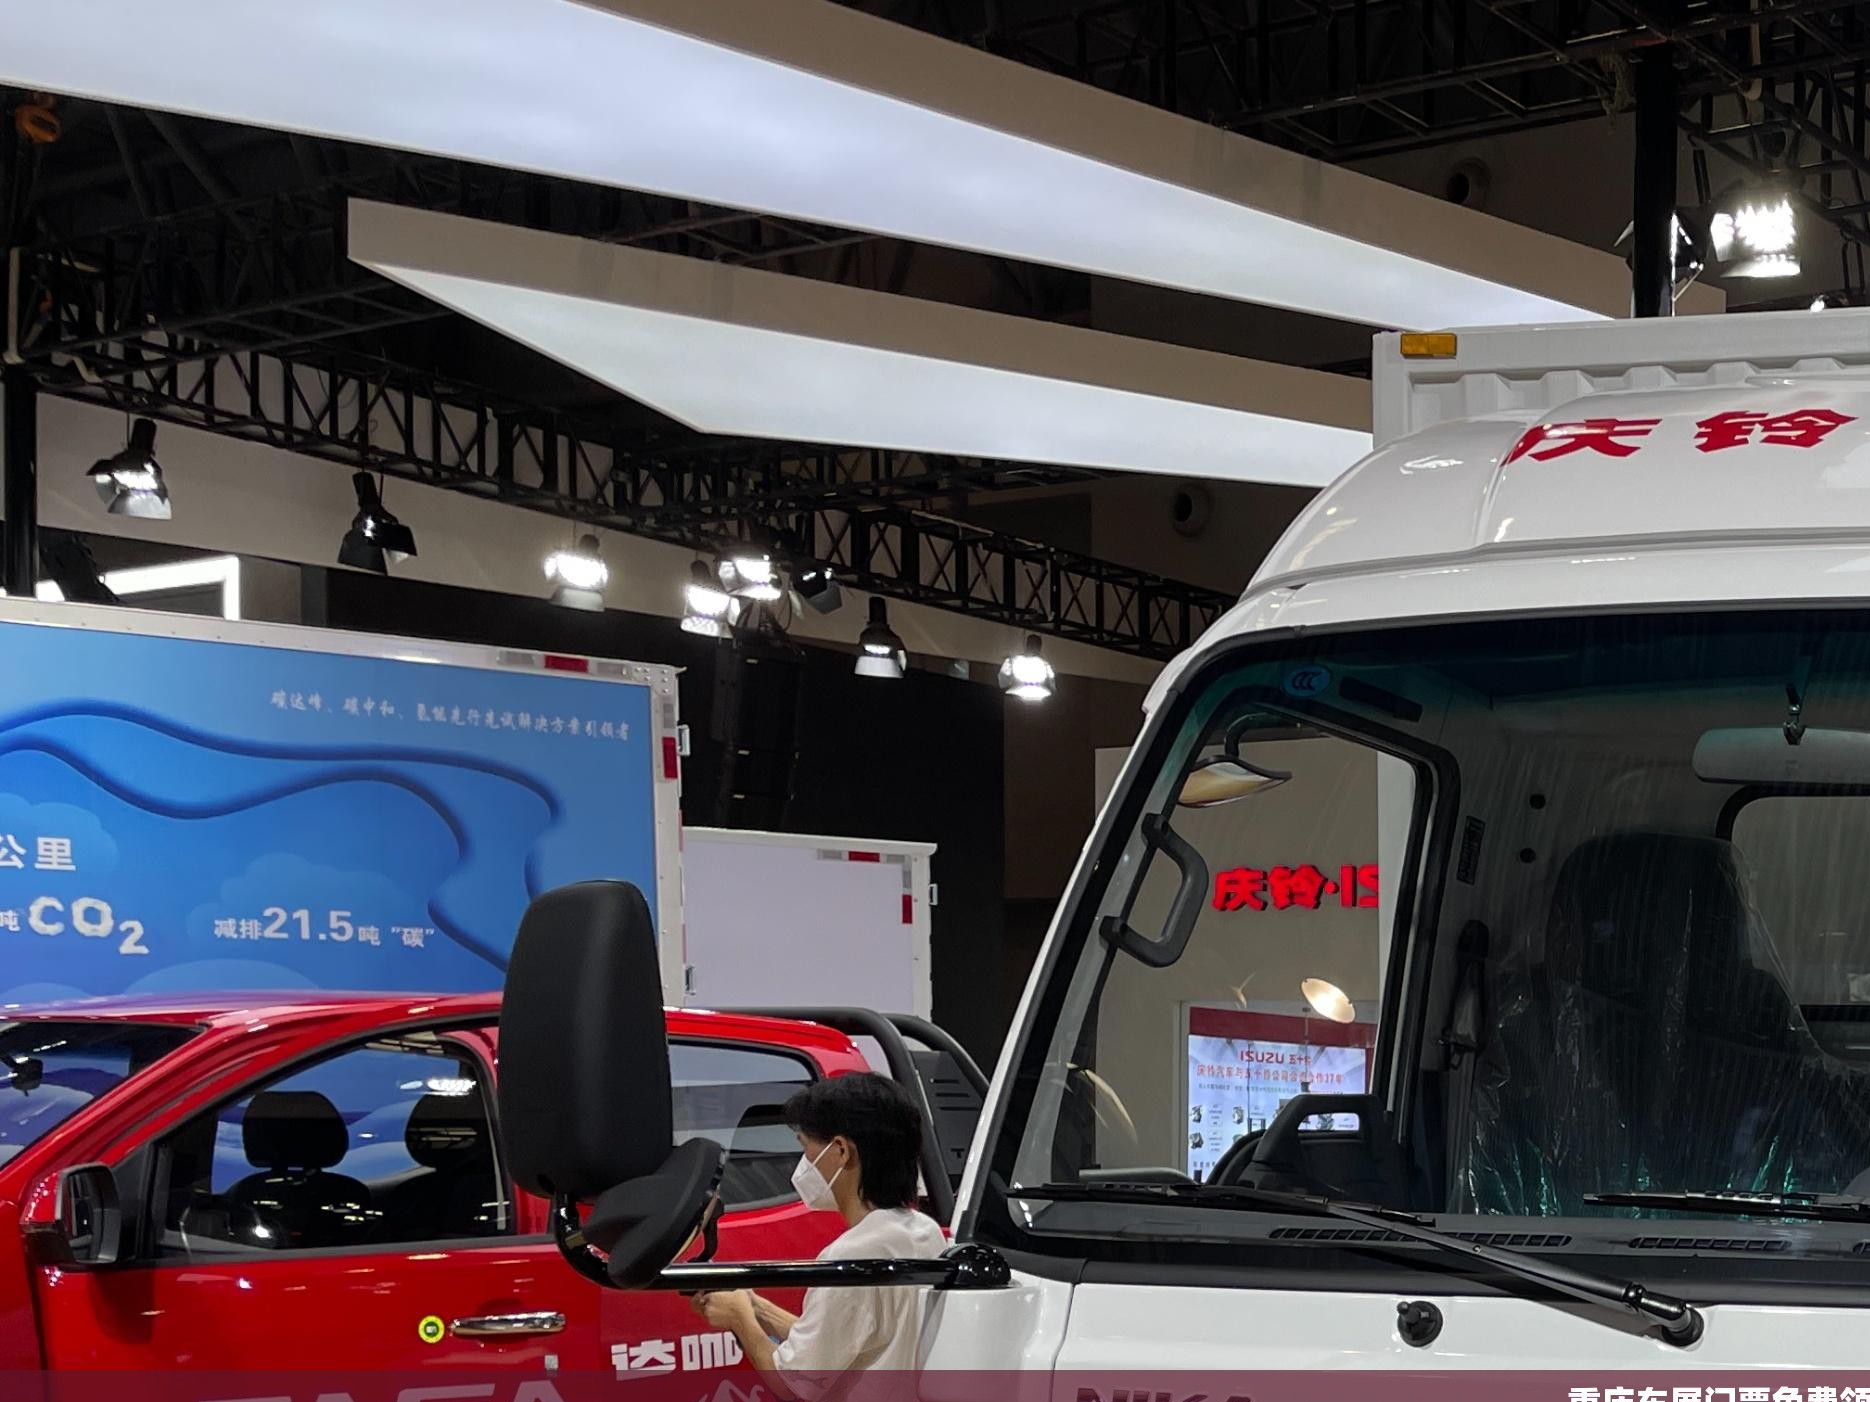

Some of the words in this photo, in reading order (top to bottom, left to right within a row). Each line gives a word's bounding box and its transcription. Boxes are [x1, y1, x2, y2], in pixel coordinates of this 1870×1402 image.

[0, 834, 76, 871] 公里
[1240, 1050, 1284, 1064] ISUZU
[611, 1331, 743, 1381] 达咖
